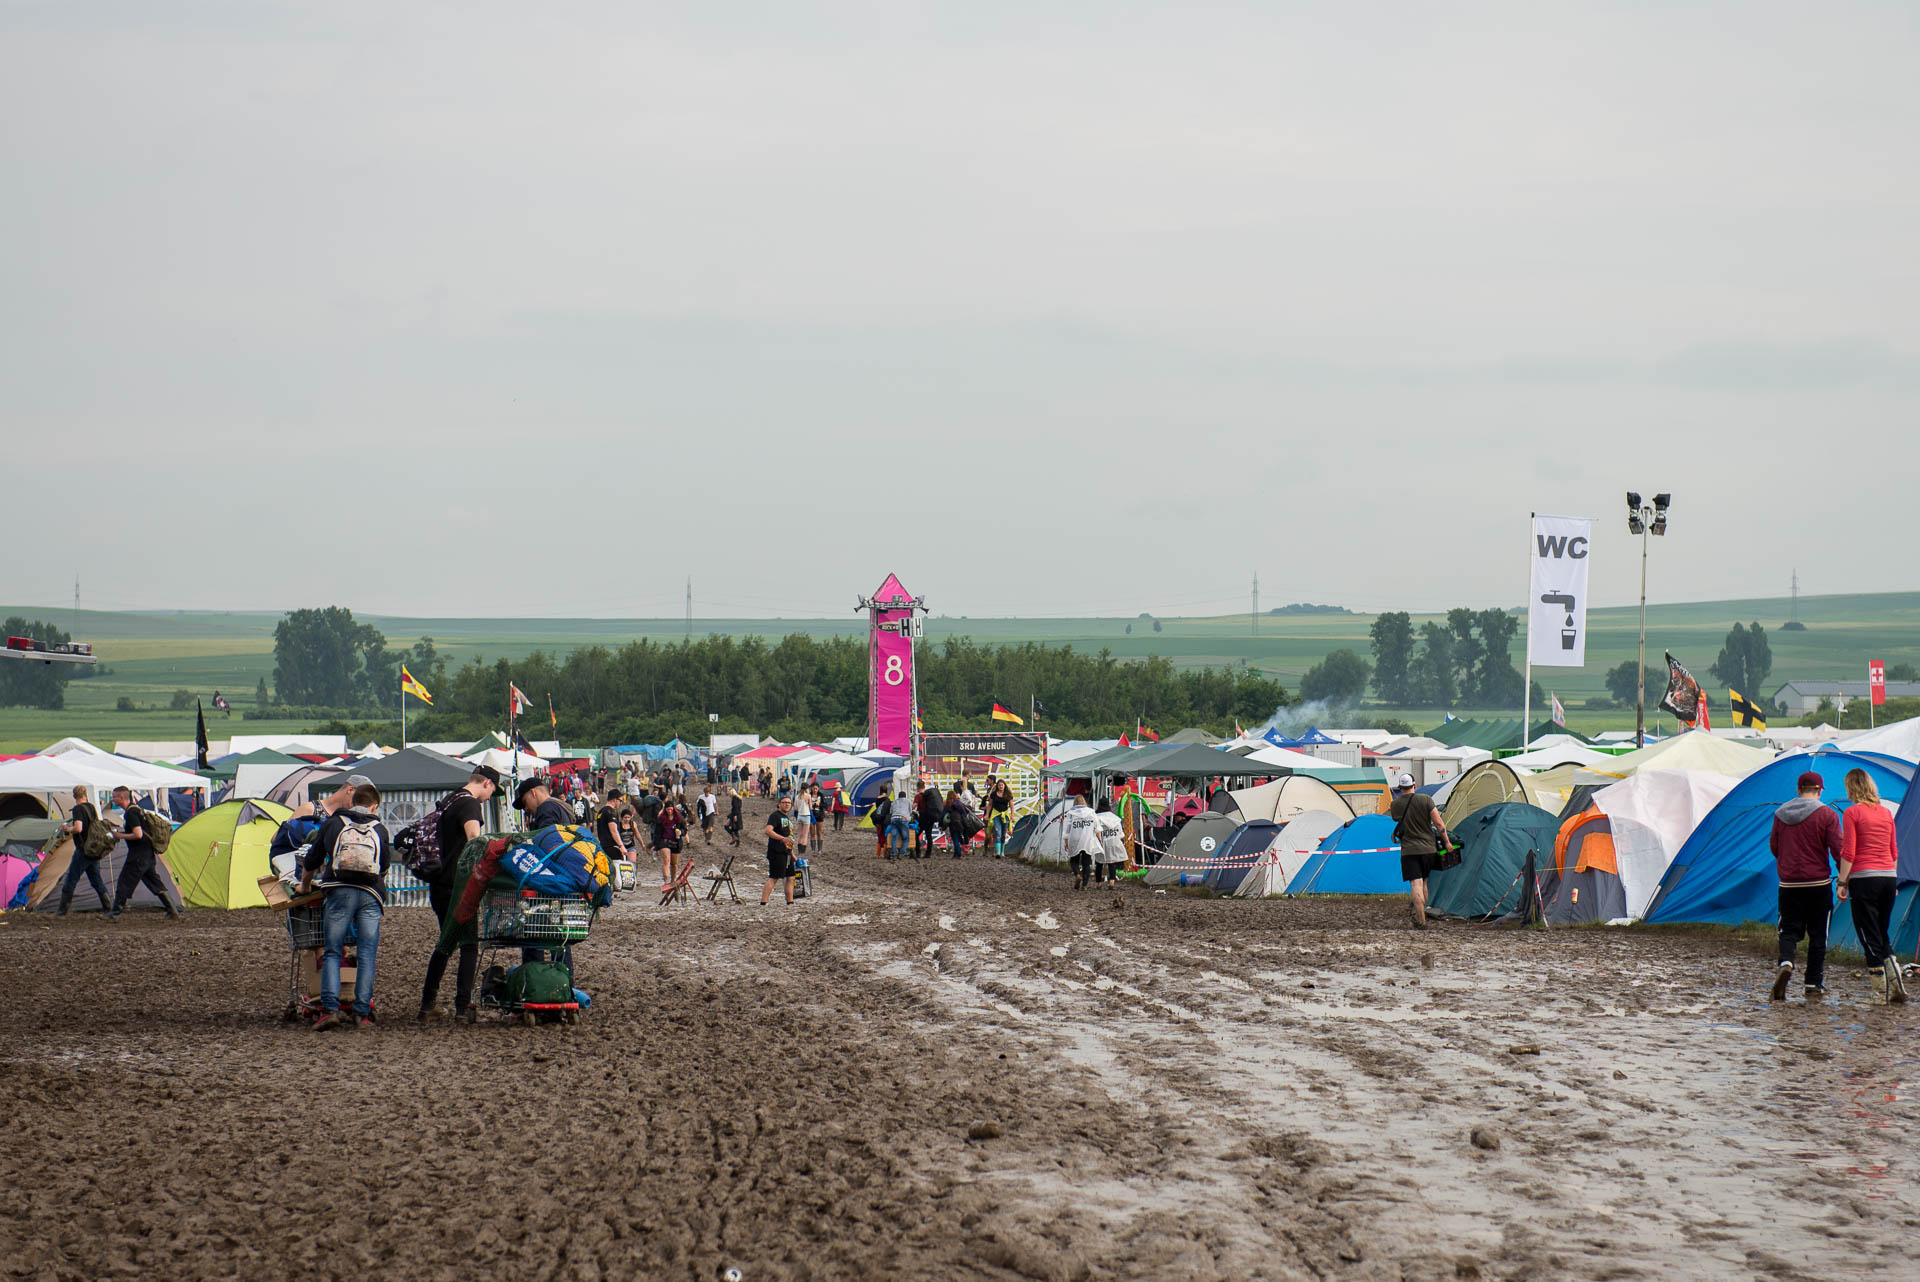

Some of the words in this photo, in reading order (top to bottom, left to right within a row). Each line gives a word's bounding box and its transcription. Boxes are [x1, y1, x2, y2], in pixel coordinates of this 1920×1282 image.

[1537, 535, 1588, 559] WC
[901, 618, 911, 637] H
[885, 655, 904, 686] 8
[959, 742, 975, 751] 3RD
[977, 741, 1006, 750] AVENUE
